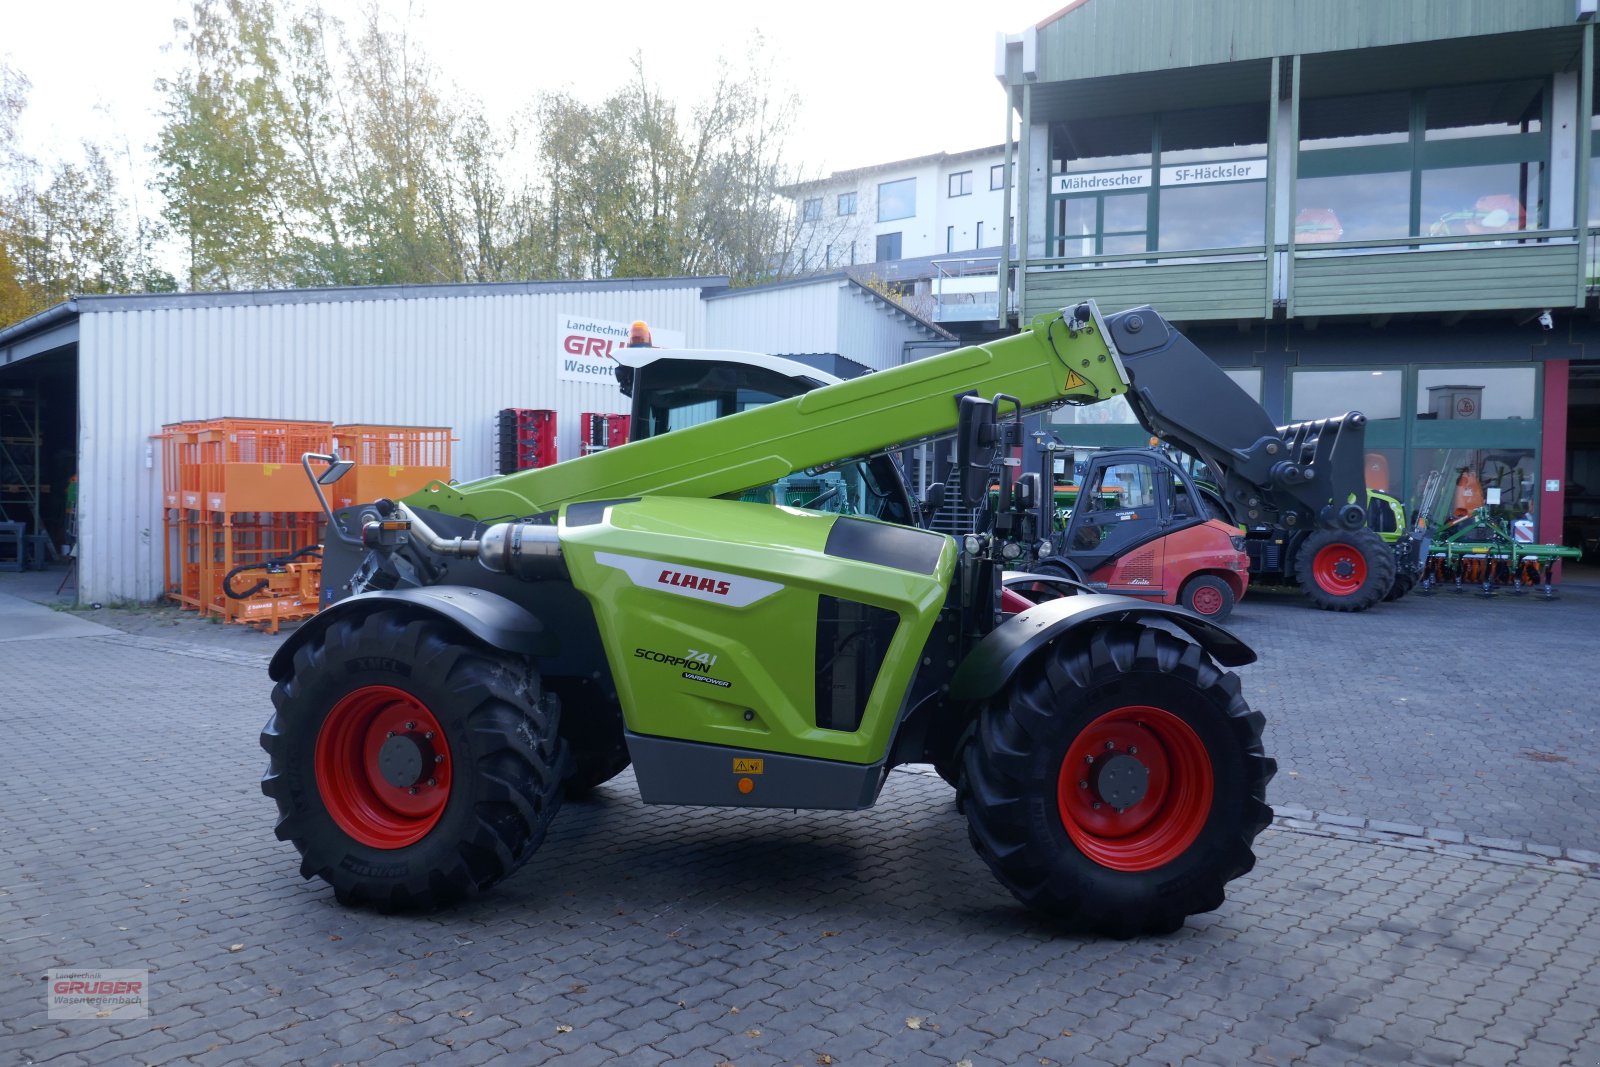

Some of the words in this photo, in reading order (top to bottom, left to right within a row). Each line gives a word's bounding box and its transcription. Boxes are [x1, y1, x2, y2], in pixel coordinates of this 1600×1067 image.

[1060, 173, 1143, 190] Mähdrescher
[1175, 165, 1252, 182] SF-Häcksler
[566, 319, 629, 338] Landtechnik
[564, 335, 628, 359] GRU
[564, 359, 616, 376] Wasent
[658, 569, 732, 596] CLAAS
[633, 648, 711, 673] SCORPION
[684, 648, 718, 667] 741
[684, 671, 730, 687] VARIPOWER
